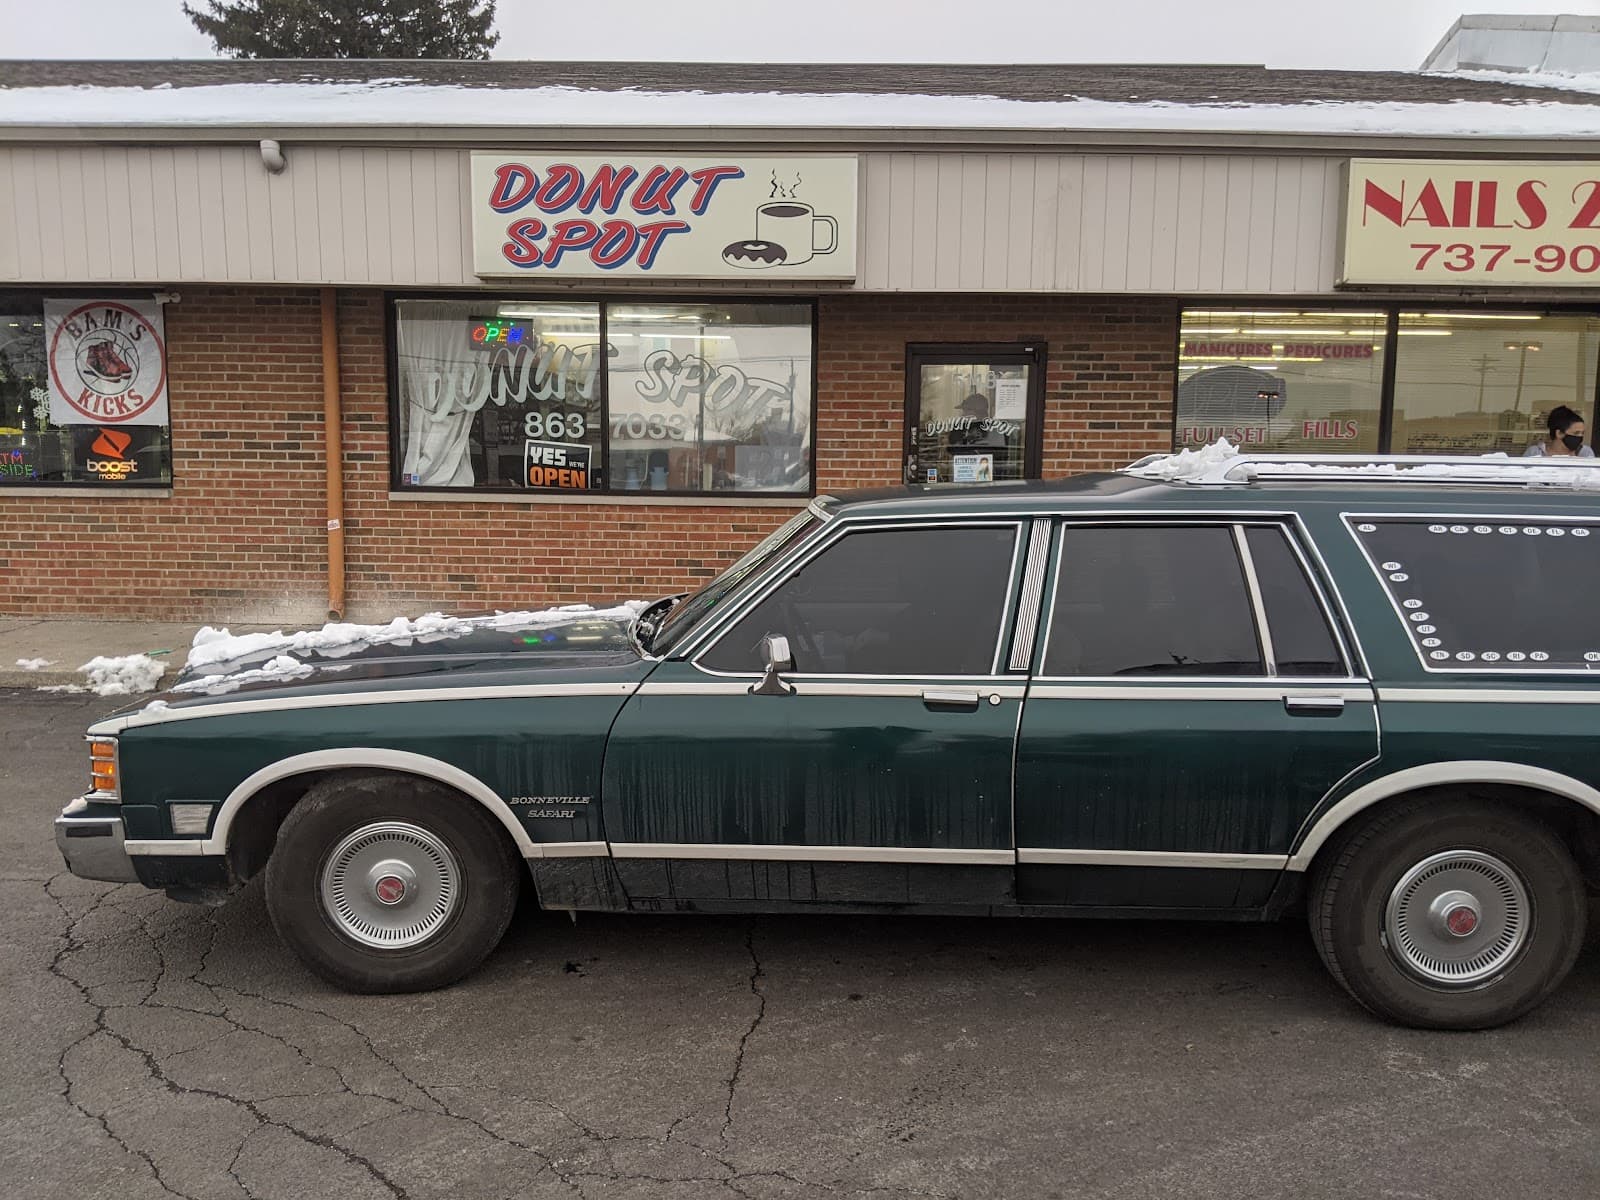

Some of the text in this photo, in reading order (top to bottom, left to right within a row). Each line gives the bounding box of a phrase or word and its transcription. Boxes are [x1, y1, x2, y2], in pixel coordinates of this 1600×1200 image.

[488, 162, 745, 215] DONUT
[1363, 178, 1548, 229] NAILS
[502, 217, 691, 270] SPOT
[1410, 244, 1600, 273] 737-90
[65, 309, 148, 342] BAM'S
[472, 325, 525, 344] OPEN
[1184, 342, 1373, 359] MANICURES PEDICURES
[635, 349, 792, 416] SPOT
[77, 388, 144, 416] KICKS
[981, 416, 1020, 436] SPOT
[1302, 420, 1358, 439] FILLS
[86, 458, 138, 473] boost
[530, 446, 566, 466] YES
[529, 466, 586, 489] OPEN
[510, 796, 591, 804] BONNEVILLE
[527, 810, 576, 818] SAFARI
